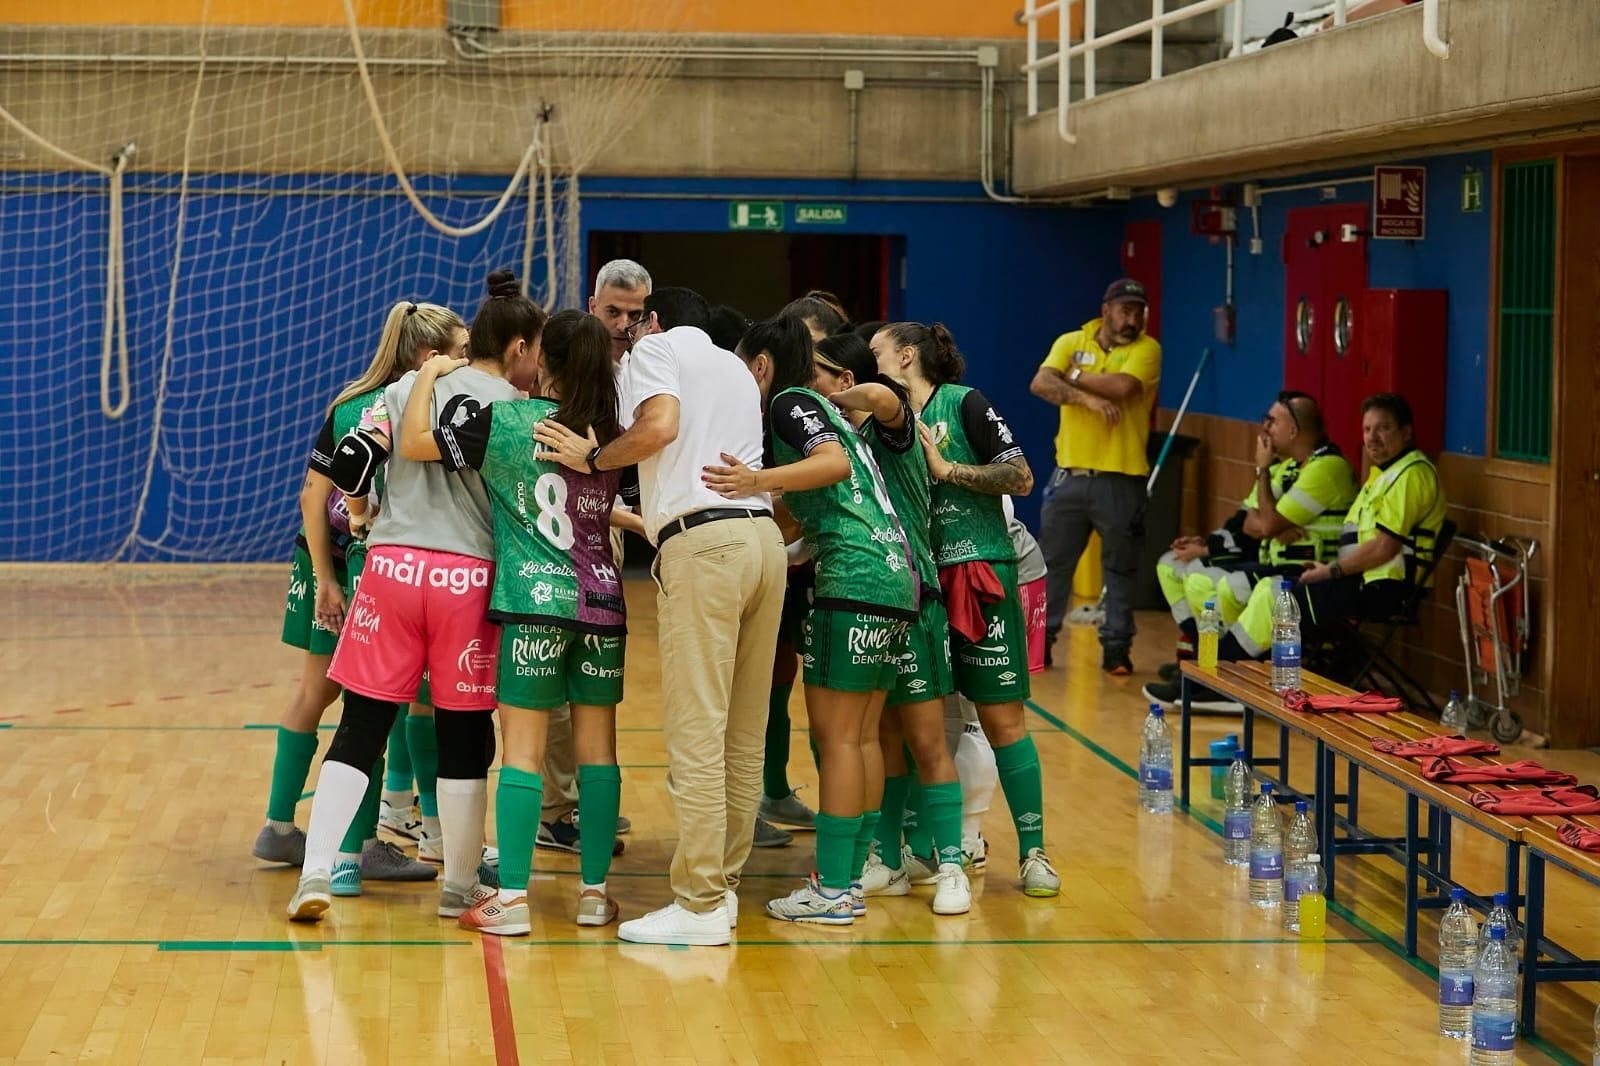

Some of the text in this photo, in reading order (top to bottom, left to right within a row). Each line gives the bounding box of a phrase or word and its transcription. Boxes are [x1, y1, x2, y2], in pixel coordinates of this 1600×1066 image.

[799, 208, 843, 220] SALIDA
[534, 472, 575, 550] 8
[518, 624, 562, 634] CLINICAS
[512, 635, 566, 666] RINCÓN
[516, 666, 557, 677] DENTAL
